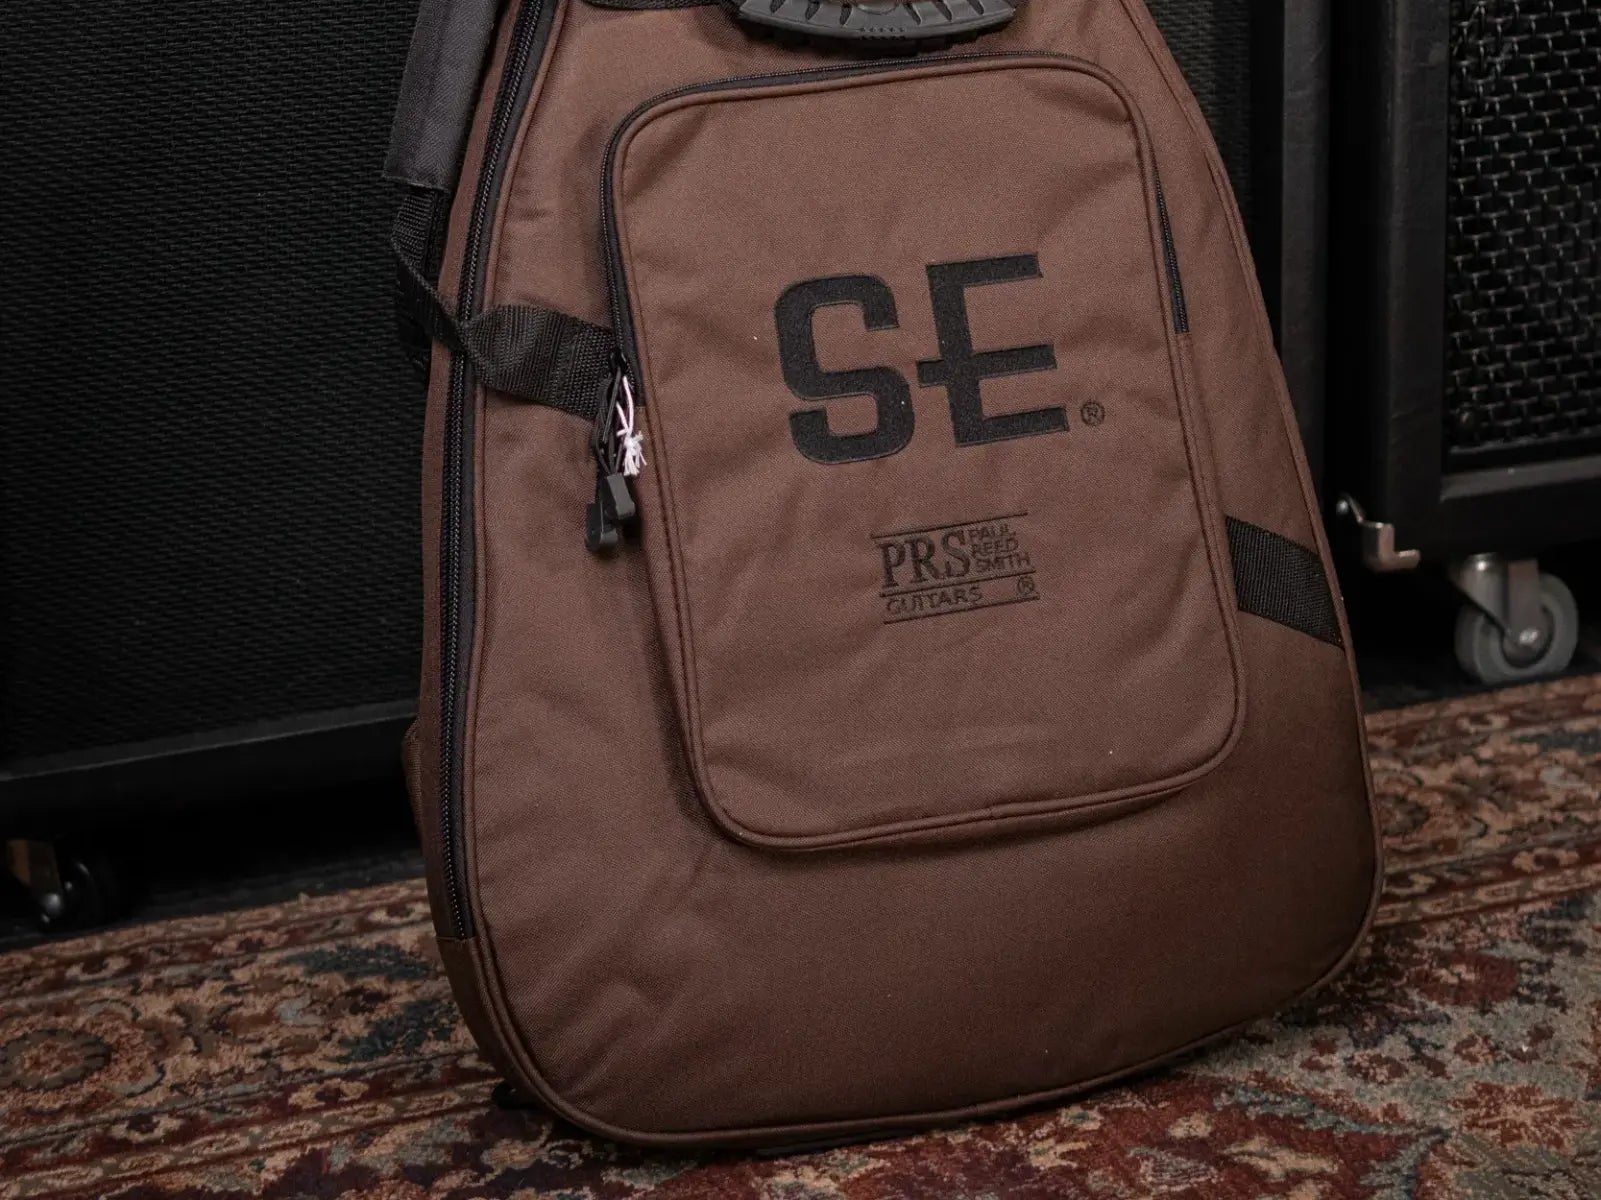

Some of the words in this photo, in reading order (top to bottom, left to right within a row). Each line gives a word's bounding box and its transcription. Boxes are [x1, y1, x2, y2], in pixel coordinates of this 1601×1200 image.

[773, 251, 1070, 464] SE
[967, 523, 1017, 541] PAUL
[877, 529, 971, 589] PRS
[971, 537, 1019, 558] REED
[975, 551, 1031, 573] SMITH
[886, 587, 982, 615] GUITARS
